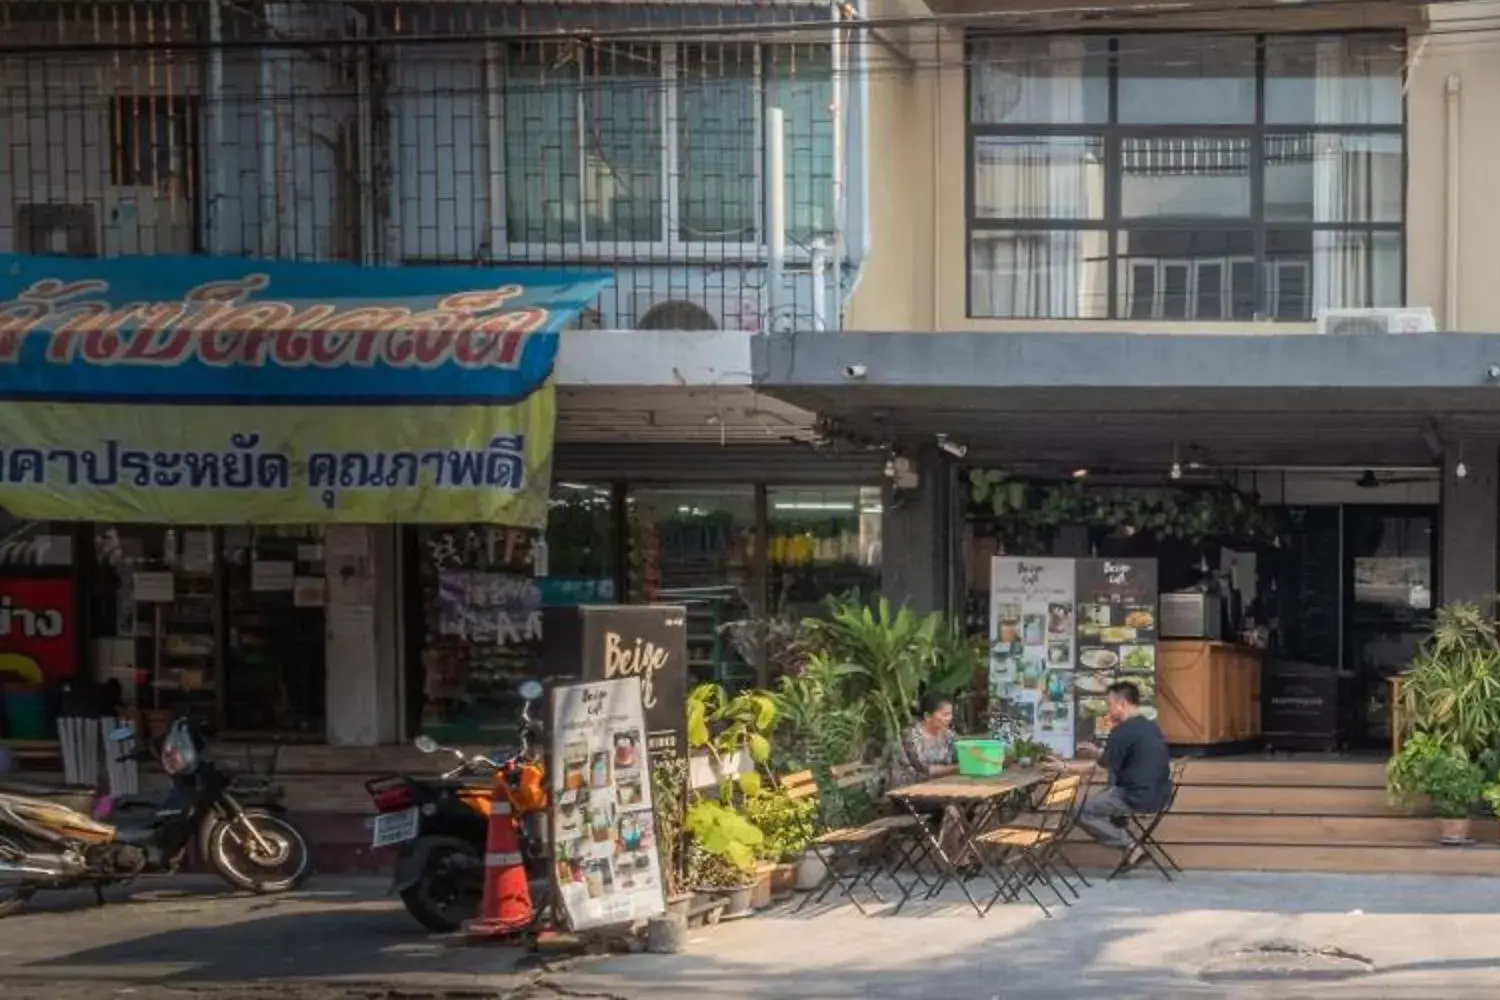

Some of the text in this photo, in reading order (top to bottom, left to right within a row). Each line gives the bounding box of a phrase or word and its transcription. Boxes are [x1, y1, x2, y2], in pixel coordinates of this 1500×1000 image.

[0, 433, 525, 508] คาประหยัด คุณภาพดี
[0, 594, 63, 637] ่าง
[604, 631, 670, 679] Beige
